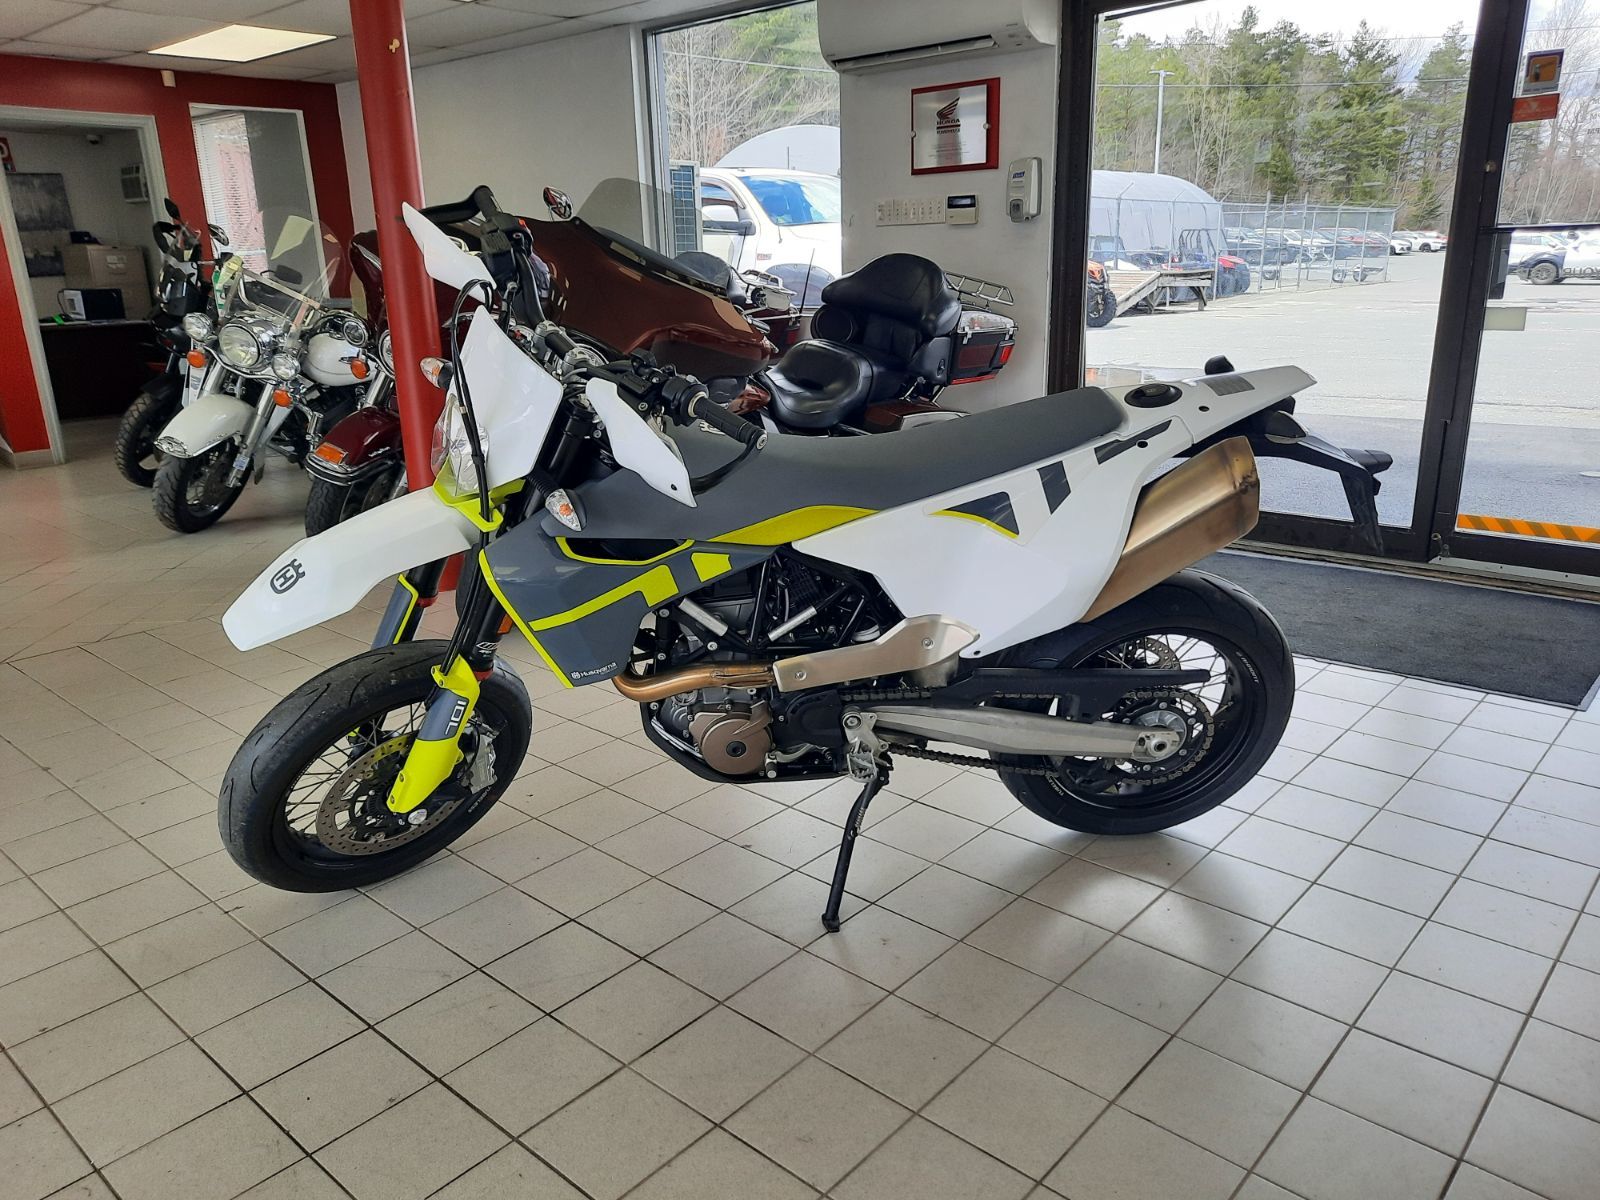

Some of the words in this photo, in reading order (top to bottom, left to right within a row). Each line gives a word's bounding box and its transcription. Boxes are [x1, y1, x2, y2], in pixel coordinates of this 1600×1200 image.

[936, 118, 961, 126] HONDA
[580, 662, 617, 678] Husqvarna
[445, 700, 467, 735] 701
